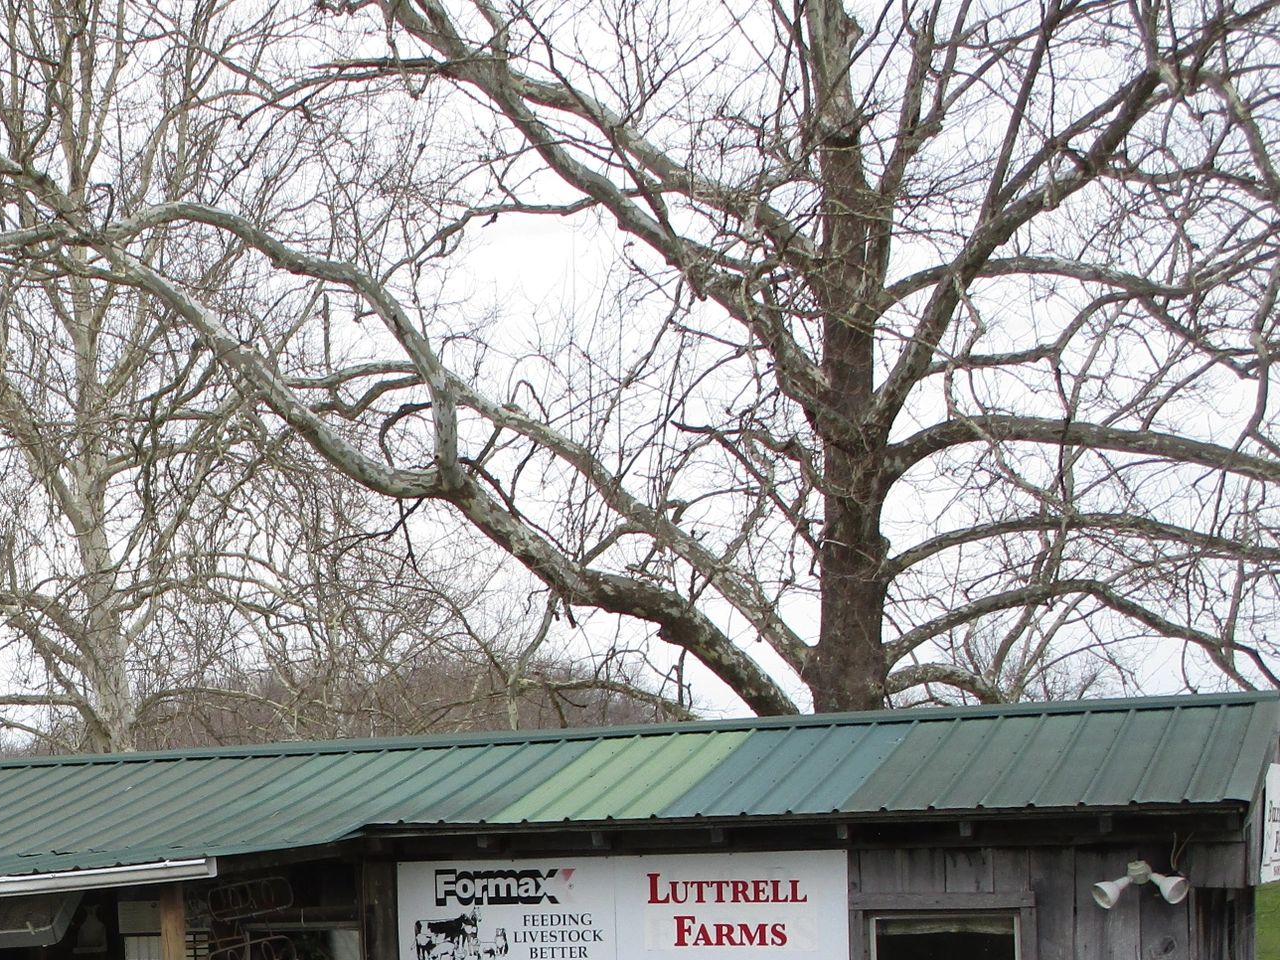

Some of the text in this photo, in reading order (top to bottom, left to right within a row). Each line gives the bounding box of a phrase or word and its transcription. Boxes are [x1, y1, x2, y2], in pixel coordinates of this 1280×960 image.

[435, 869, 560, 906] Formax
[647, 873, 807, 904] LUTTRELL
[523, 913, 592, 926] FEEDING
[514, 929, 604, 943] LIVESTOCK
[674, 916, 787, 946] FARMS
[530, 946, 588, 959] BETTER
